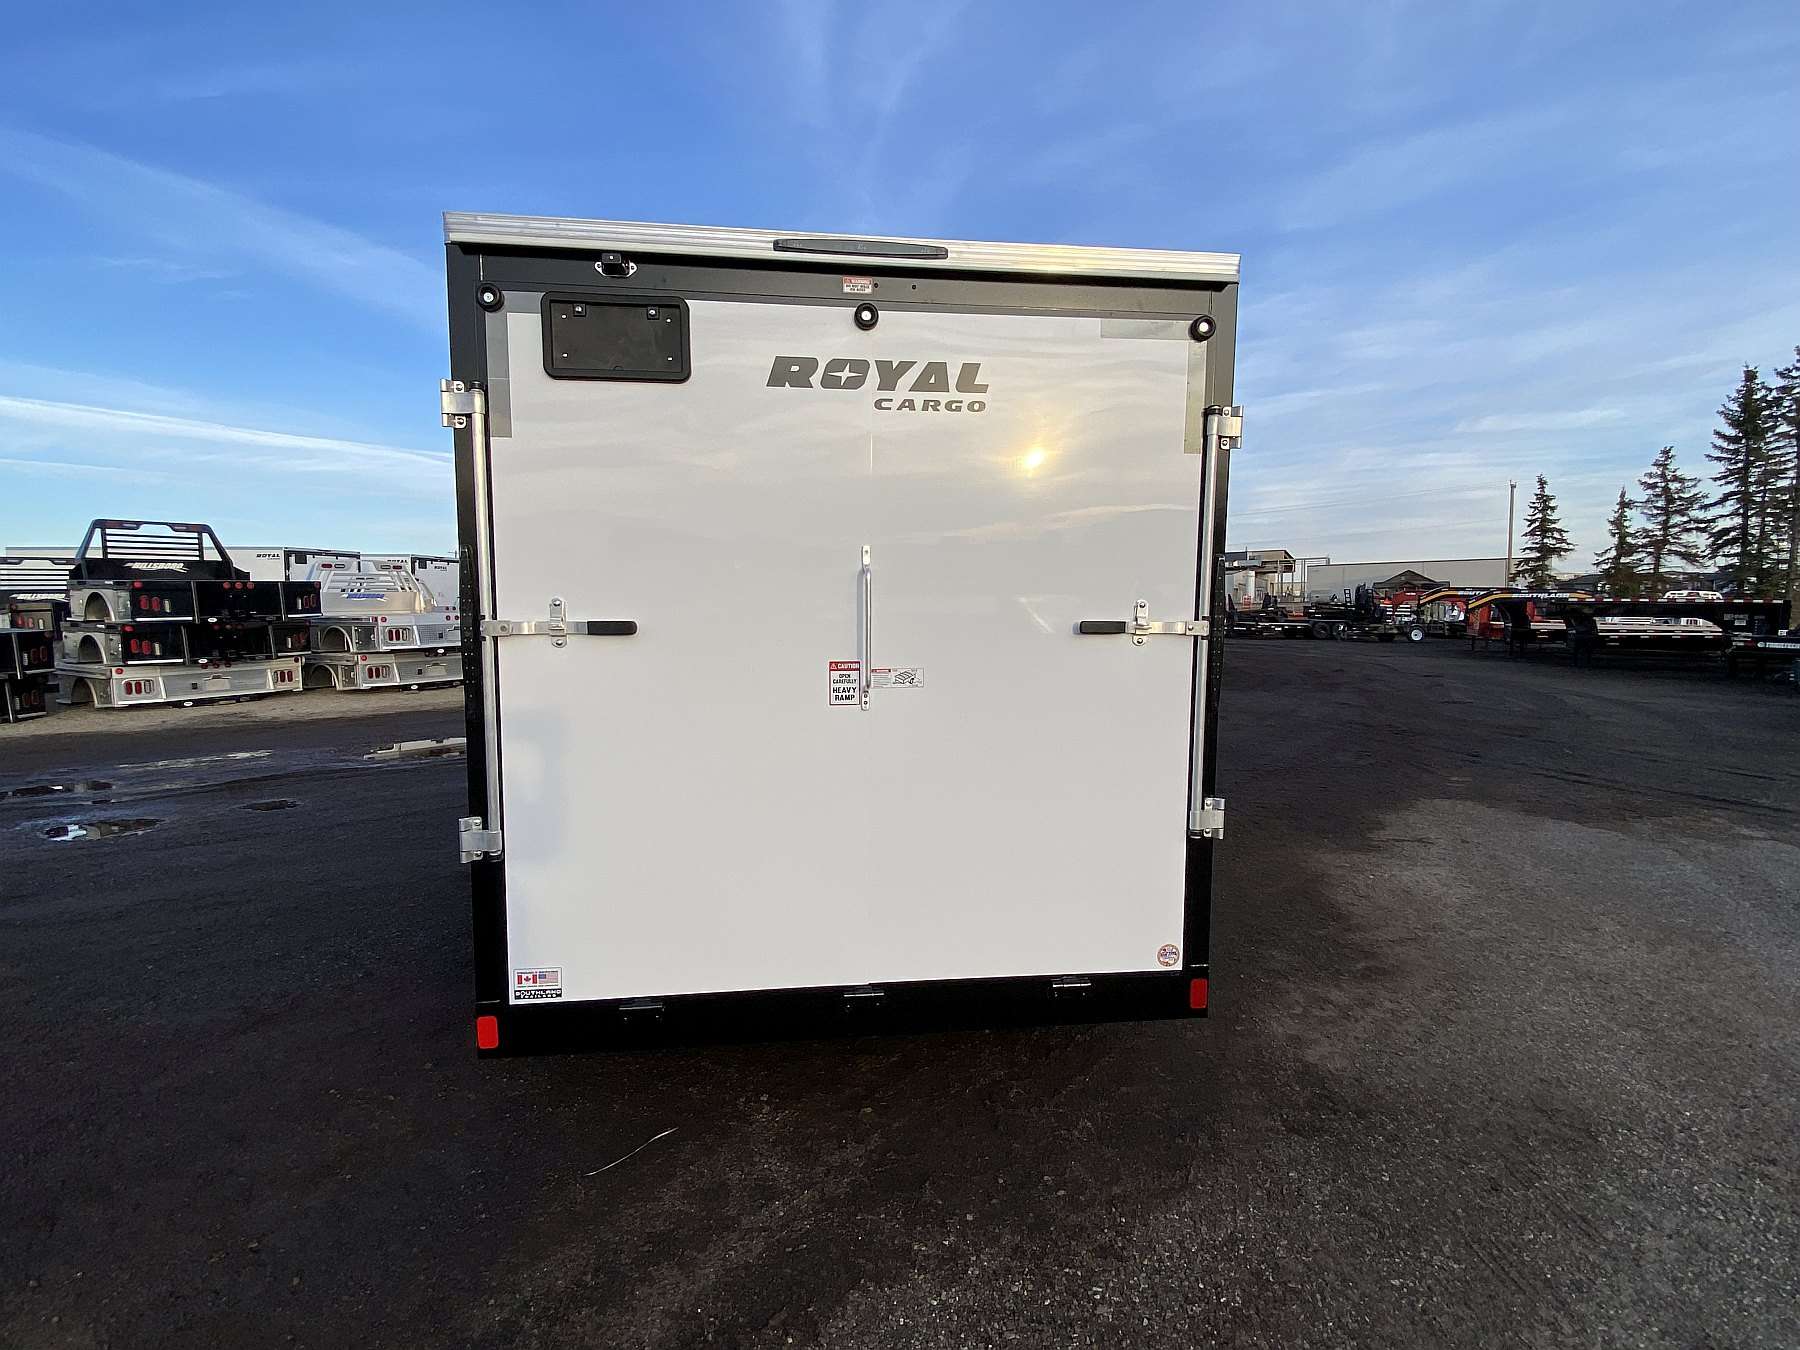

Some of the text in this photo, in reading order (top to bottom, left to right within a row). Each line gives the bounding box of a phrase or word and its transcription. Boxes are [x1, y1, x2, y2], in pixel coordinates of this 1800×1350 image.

[766, 356, 989, 393] ROYAL
[874, 398, 986, 413] CARGO
[832, 686, 857, 694] HEAVY
